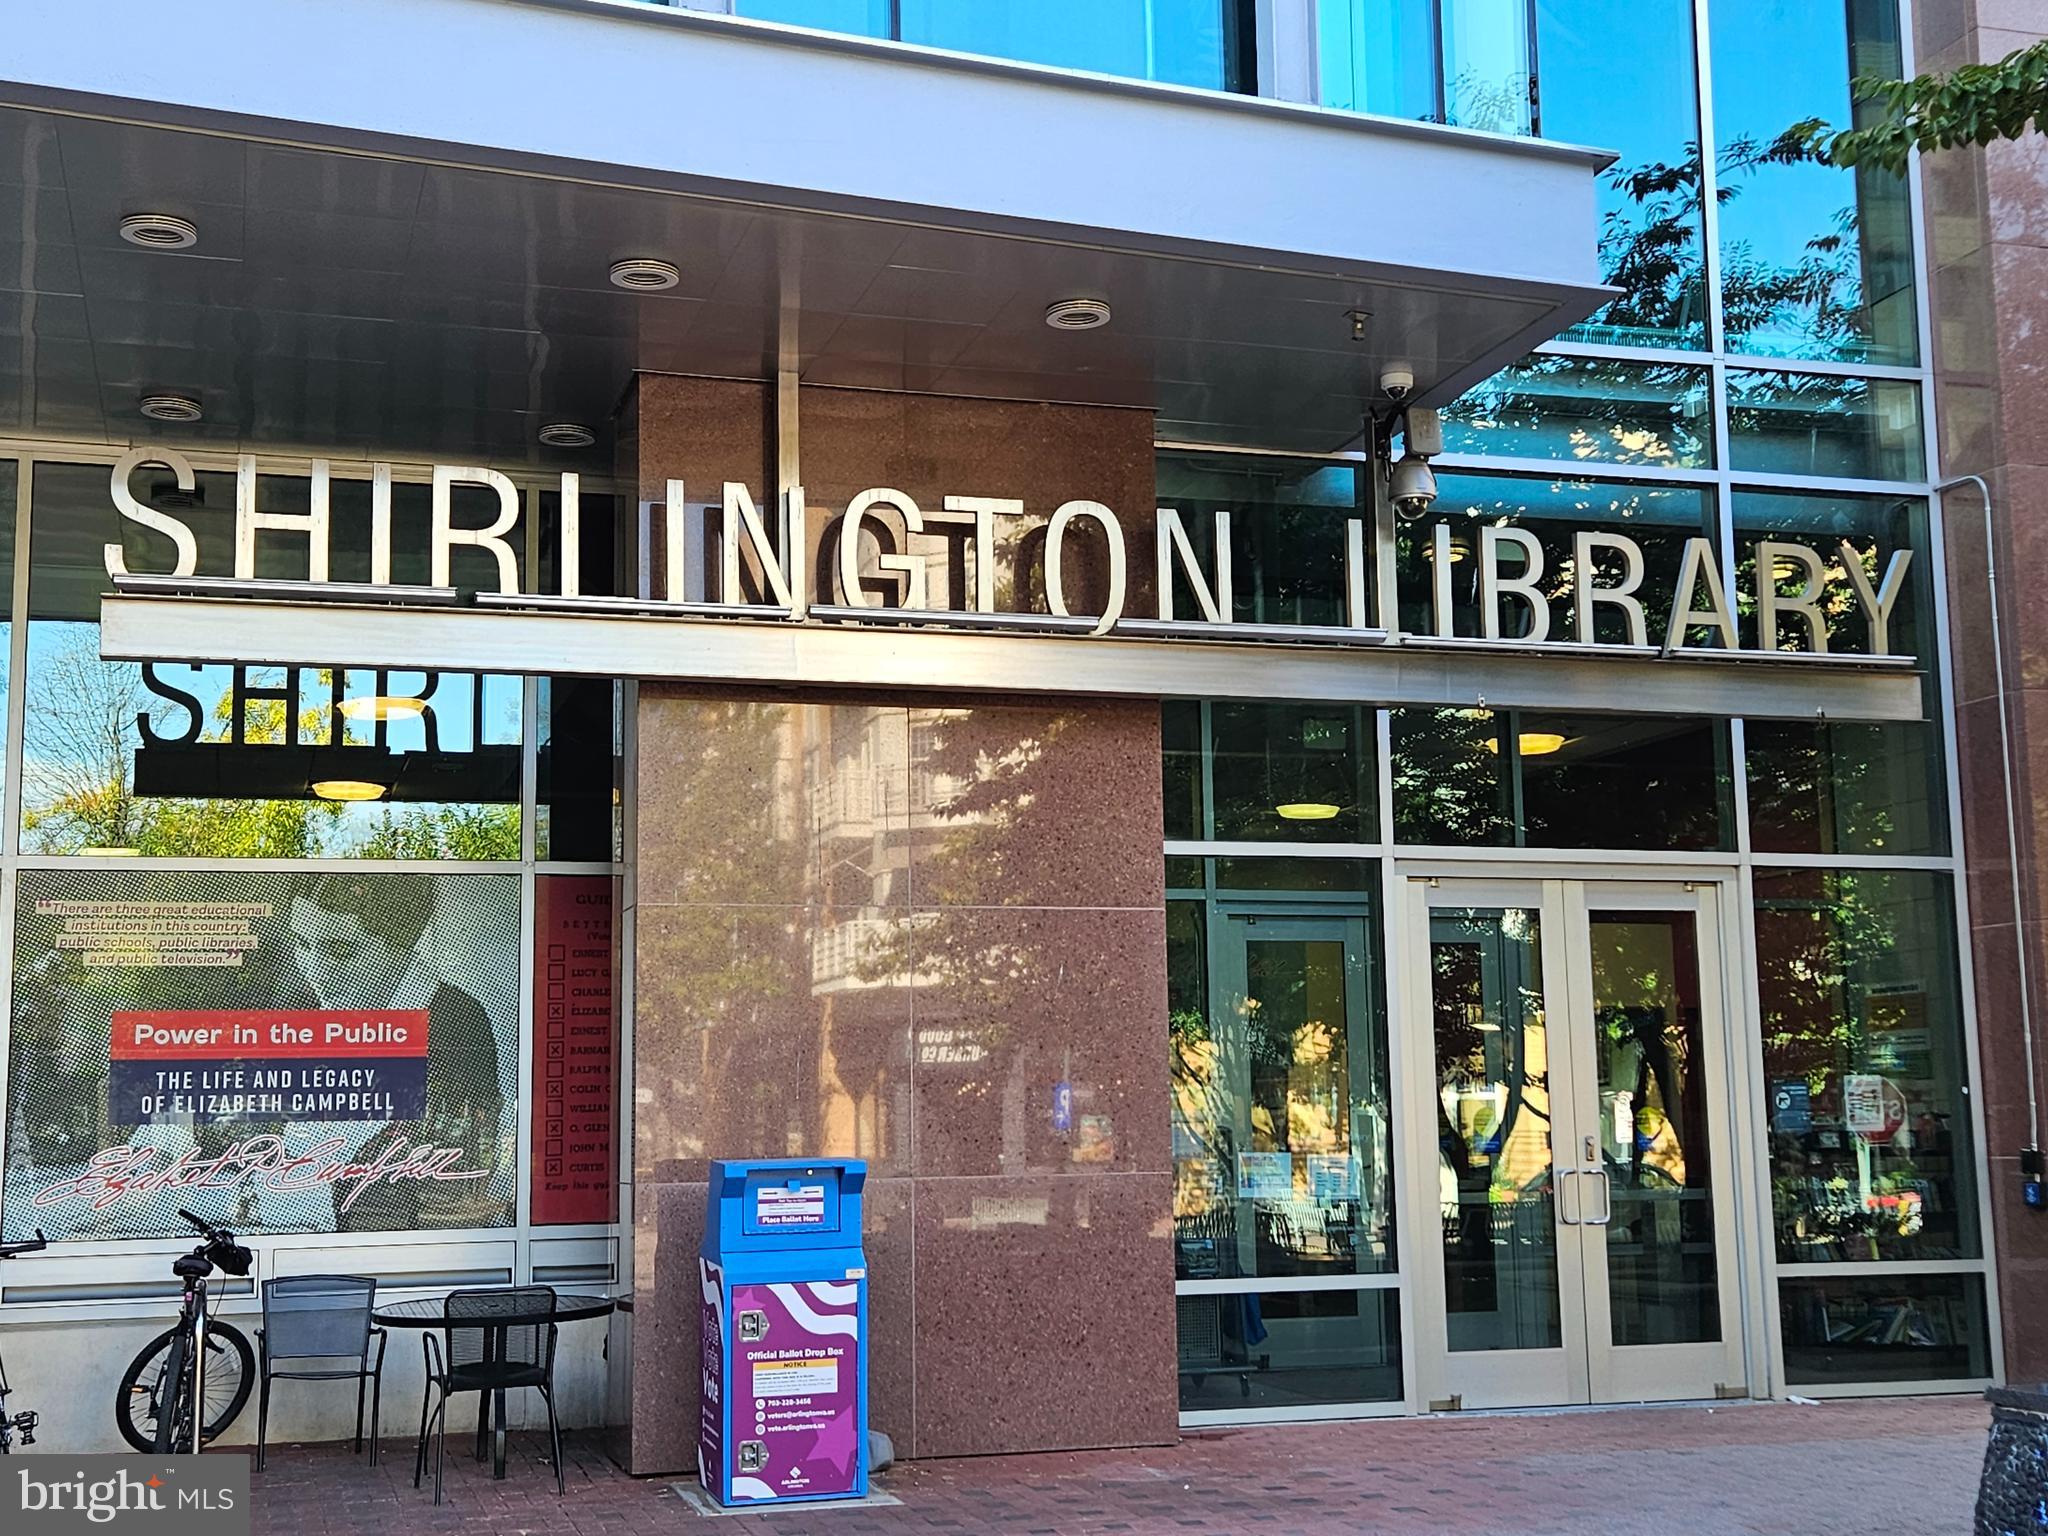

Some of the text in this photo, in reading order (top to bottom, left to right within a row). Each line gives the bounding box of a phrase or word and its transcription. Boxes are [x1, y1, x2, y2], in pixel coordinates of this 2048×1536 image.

[103, 446, 1913, 655] SHIRLINGTON LIBRARY
[92, 904, 112, 914] are
[116, 903, 150, 914] three
[154, 904, 188, 917] great
[191, 903, 267, 915] educational
[71, 920, 247, 934] institutions in this country:
[59, 936, 257, 949] public schools, public libraries,
[89, 953, 114, 964] and
[117, 953, 158, 966] public
[134, 1022, 408, 1045] Power in the Public
[156, 1069, 375, 1090] THE LIFE AND LEGACY
[569, 1085, 600, 1094] COLIN
[141, 1092, 395, 1114] OF ELIZABETH CAMPBELL
[569, 1143, 596, 1153] JOHN
[762, 1216, 780, 1224] Place
[781, 1215, 802, 1223] Ballot
[747, 1347, 844, 1360] Official Ballot Drop Box
[702, 1366, 719, 1404] Vote
